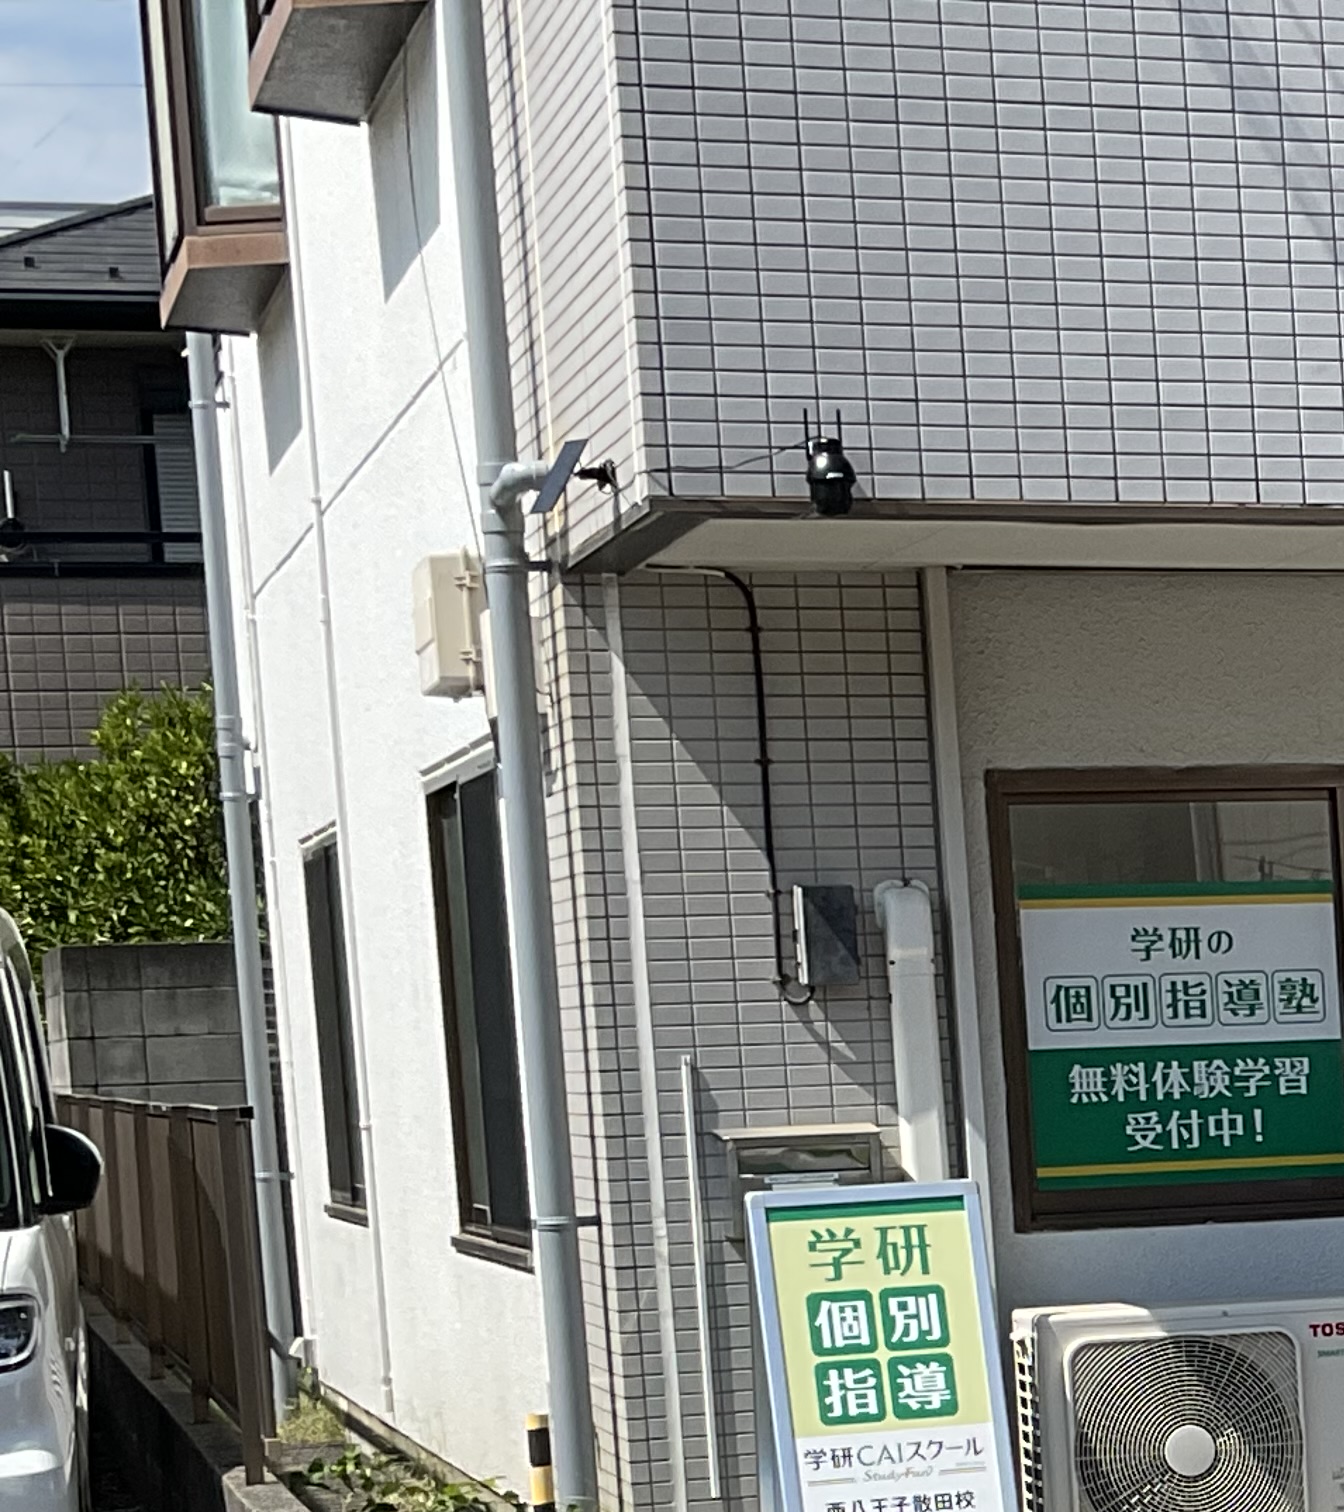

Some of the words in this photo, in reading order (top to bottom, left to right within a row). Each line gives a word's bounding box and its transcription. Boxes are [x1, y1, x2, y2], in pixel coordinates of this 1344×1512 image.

[1131, 926, 1234, 962] 学研の
[1049, 974, 1321, 1026] 個別指導塾
[1068, 1056, 1311, 1104] 無料体験学習
[1124, 1107, 1265, 1152] 受付中!
[807, 1223, 932, 1282] 学研
[813, 1292, 943, 1349] 個別
[821, 1360, 954, 1420] 指導
[803, 1437, 985, 1471] 学研CAIスクール
